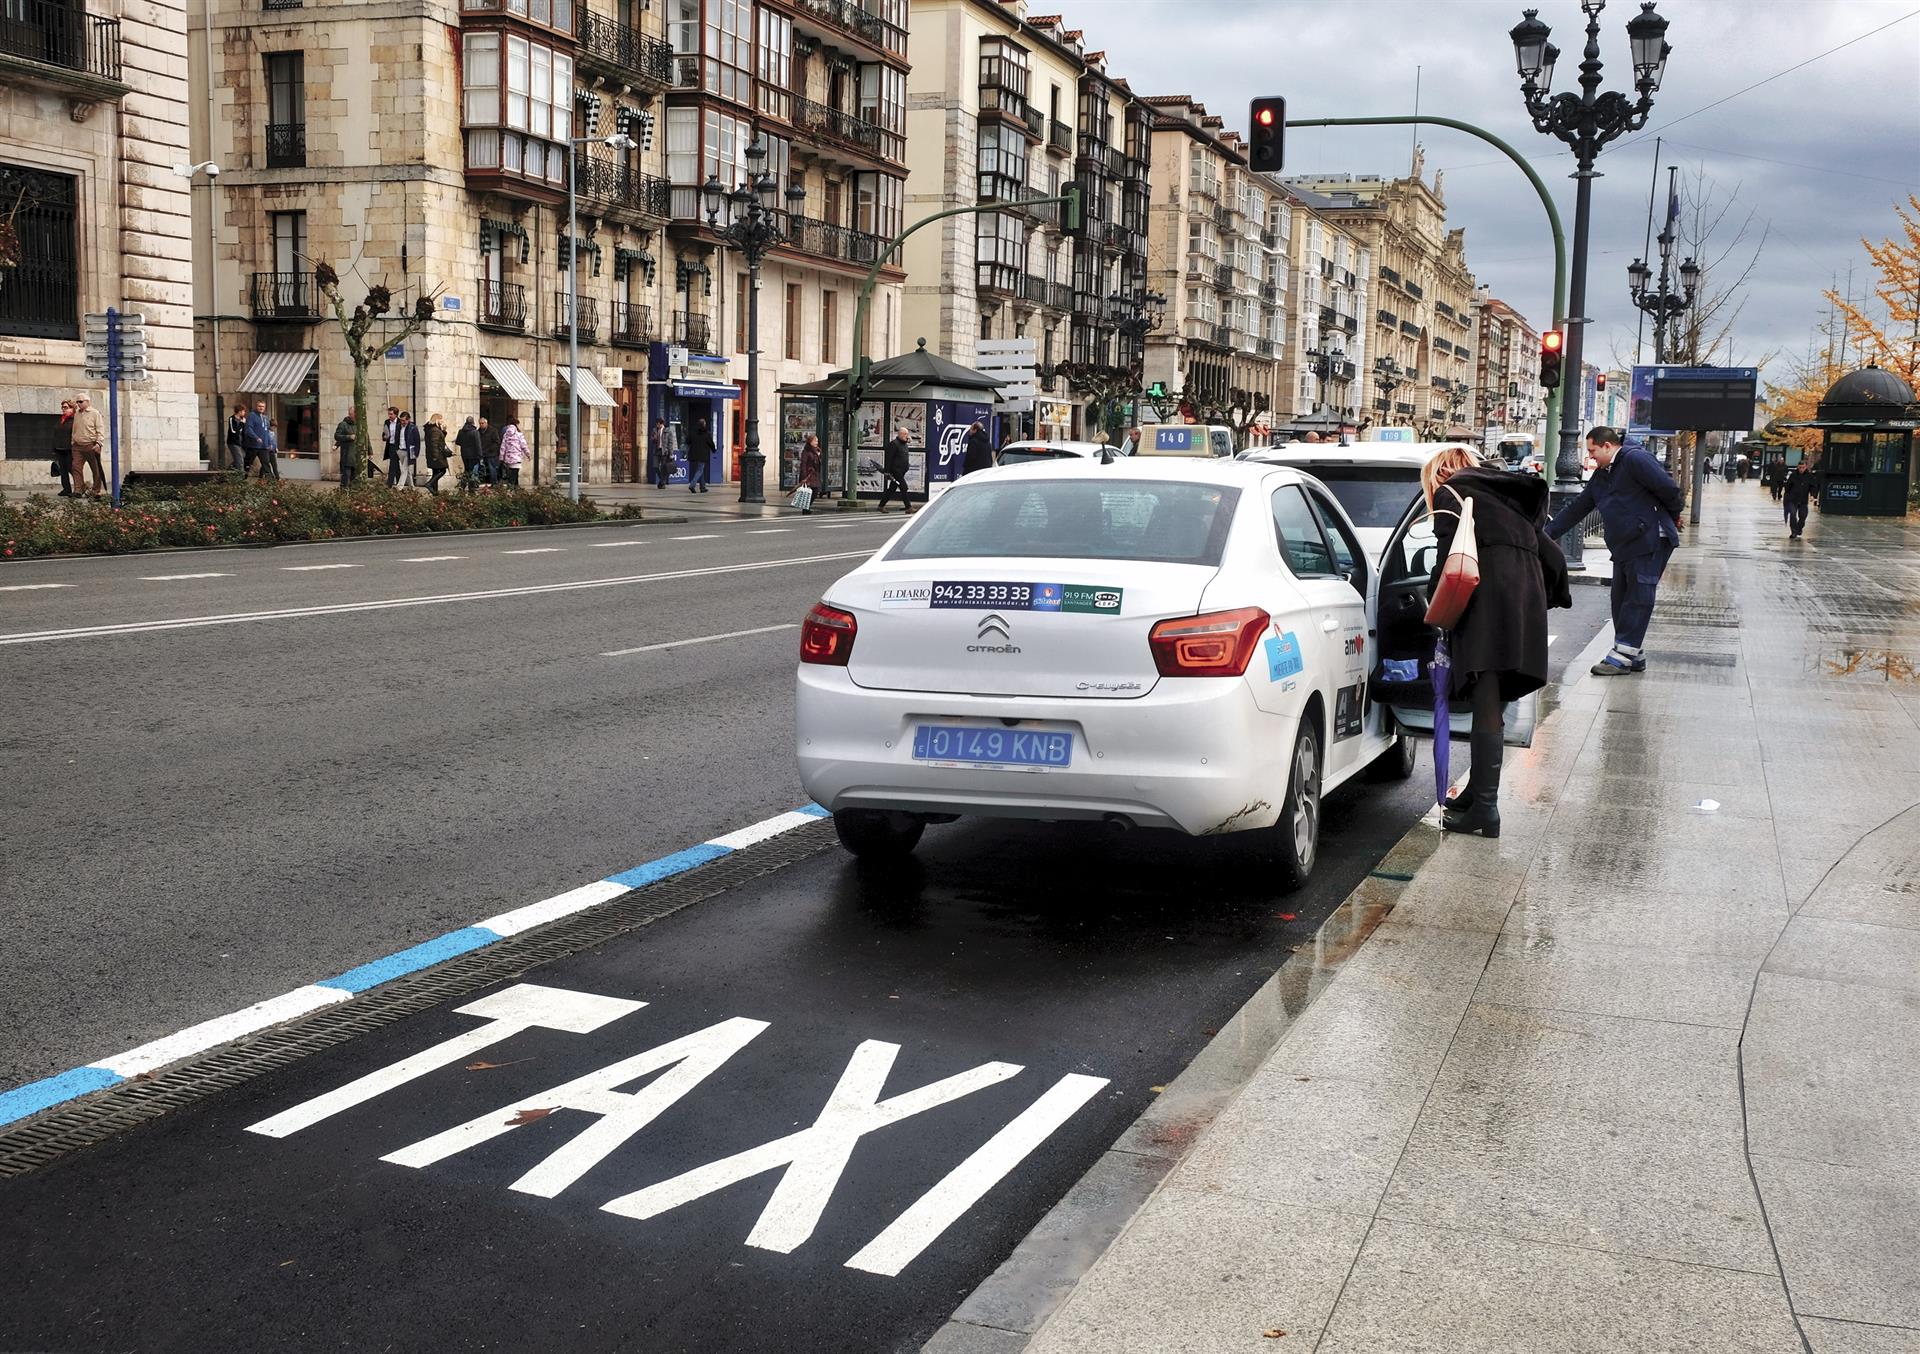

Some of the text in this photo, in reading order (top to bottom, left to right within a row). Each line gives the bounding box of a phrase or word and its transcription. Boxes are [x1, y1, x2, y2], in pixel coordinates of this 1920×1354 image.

[1160, 432, 1184, 443] 140
[883, 588, 930, 598] EL DIARIO
[934, 586, 1030, 600] 942 33 33 33
[934, 730, 1066, 762] 0149 KNB
[243, 983, 1111, 1276] TAXI
